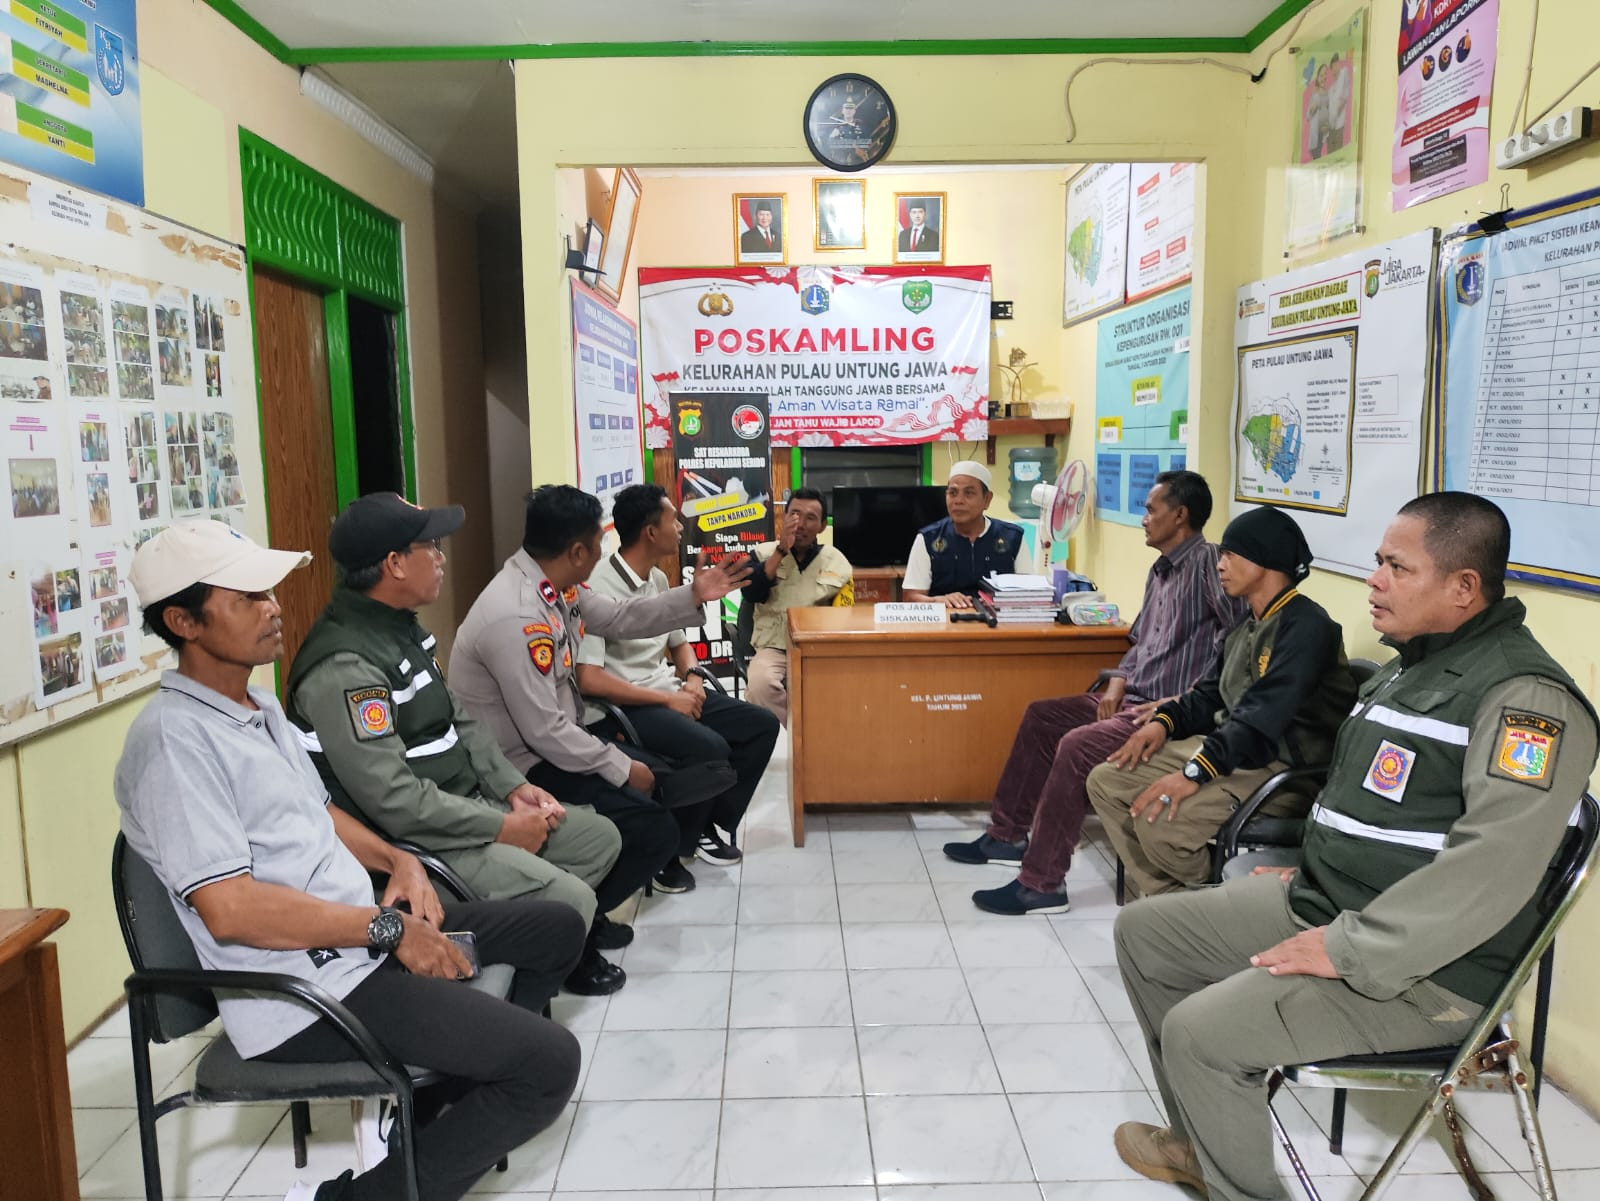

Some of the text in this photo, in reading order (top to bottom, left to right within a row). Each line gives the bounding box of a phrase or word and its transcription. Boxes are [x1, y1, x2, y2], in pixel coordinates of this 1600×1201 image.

[35, 17, 63, 38] FITRIYAH
[1403, 37, 1428, 66] LAWAN
[1428, 24, 1445, 44] DAN
[47, 135, 65, 149] YANTI
[1529, 232, 1550, 246] PIKET
[1551, 225, 1578, 241] SISTEM
[1544, 242, 1593, 262] KELURAHAN
[1380, 258, 1402, 275] JAGA
[1113, 299, 1190, 338] STRUKTUR ORGANISASI
[694, 326, 934, 354] POSKAMLING
[1251, 347, 1334, 369] PETA PULAU UNTUNG JAWA
[682, 361, 948, 380] KELURAHAN PULAU UNTUNG JAWA
[794, 385, 853, 396] TANGGUNG
[856, 384, 893, 395] JAWAB
[896, 382, 946, 395] BERSAMA
[777, 400, 816, 411] Aman
[821, 399, 872, 411] Wisata
[774, 418, 881, 428] JAM TAMU WAJIB LAPOR
[679, 458, 705, 469] POLRES
[706, 507, 757, 527] TANPA NARKOBA
[715, 532, 739, 543] Siapa
[724, 542, 746, 553] kudu
[927, 703, 950, 711] TAHUN
